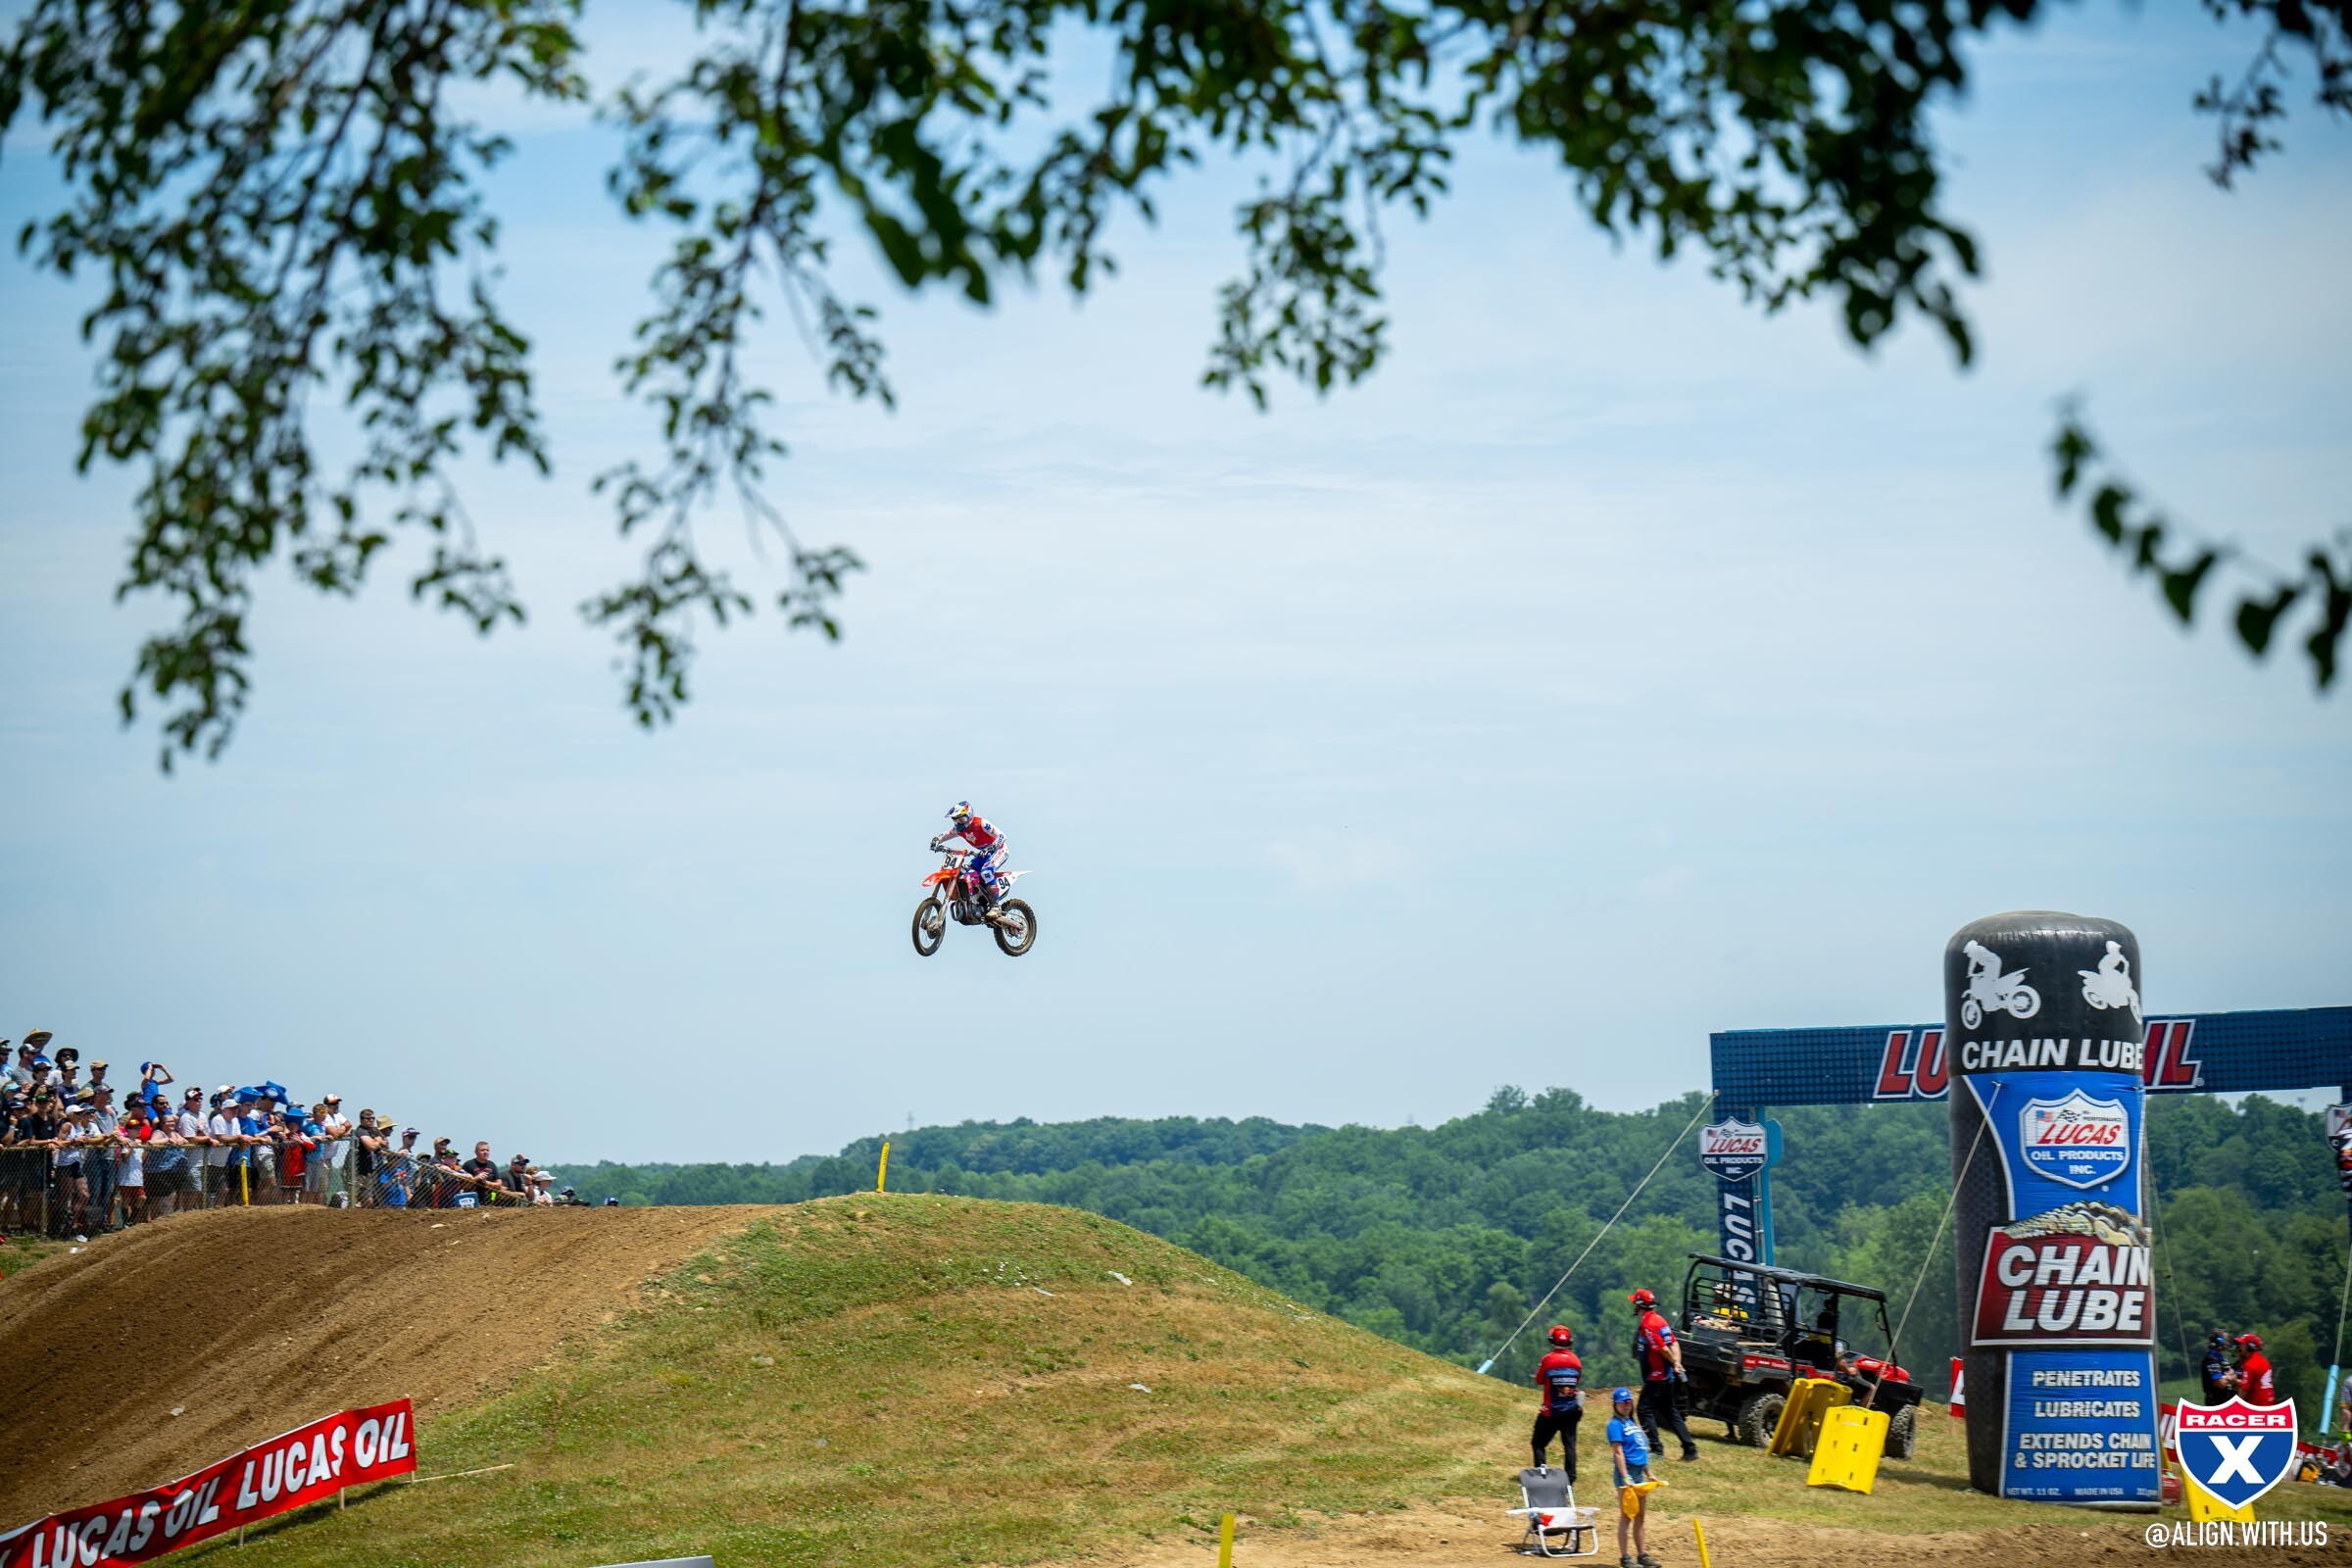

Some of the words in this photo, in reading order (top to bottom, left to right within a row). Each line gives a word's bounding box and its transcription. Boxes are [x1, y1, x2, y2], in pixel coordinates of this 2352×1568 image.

[944, 856, 957, 869] 94
[998, 877, 1011, 890] 94
[1961, 1039, 2070, 1070] CHAIN
[2078, 1039, 2143, 1070] LUBE
[2036, 1123, 2122, 1145] LUCAS
[1708, 1138, 1762, 1152] LUCAS
[2031, 1151, 2056, 1160] OIL
[2058, 1151, 2125, 1160] PRODUCTS
[2069, 1164, 2097, 1174] INC.
[1997, 1245, 2150, 1287] CHAIN
[2002, 1290, 2145, 1332] LUBE
[2032, 1370, 2141, 1387] PENETRATES
[2034, 1400, 2141, 1417] LUBRICATES
[2019, 1433, 2104, 1449] EXTENDS
[2108, 1433, 2152, 1449] CHAIN
[235, 1425, 347, 1510] LUCAS
[355, 1411, 410, 1468] OIL
[2014, 1453, 2028, 1468] &
[2033, 1452, 2130, 1468] SPROCKET
[2132, 1452, 2155, 1468] LIFE
[31, 1500, 162, 1568] LUCAS
[164, 1476, 220, 1538] OIL
